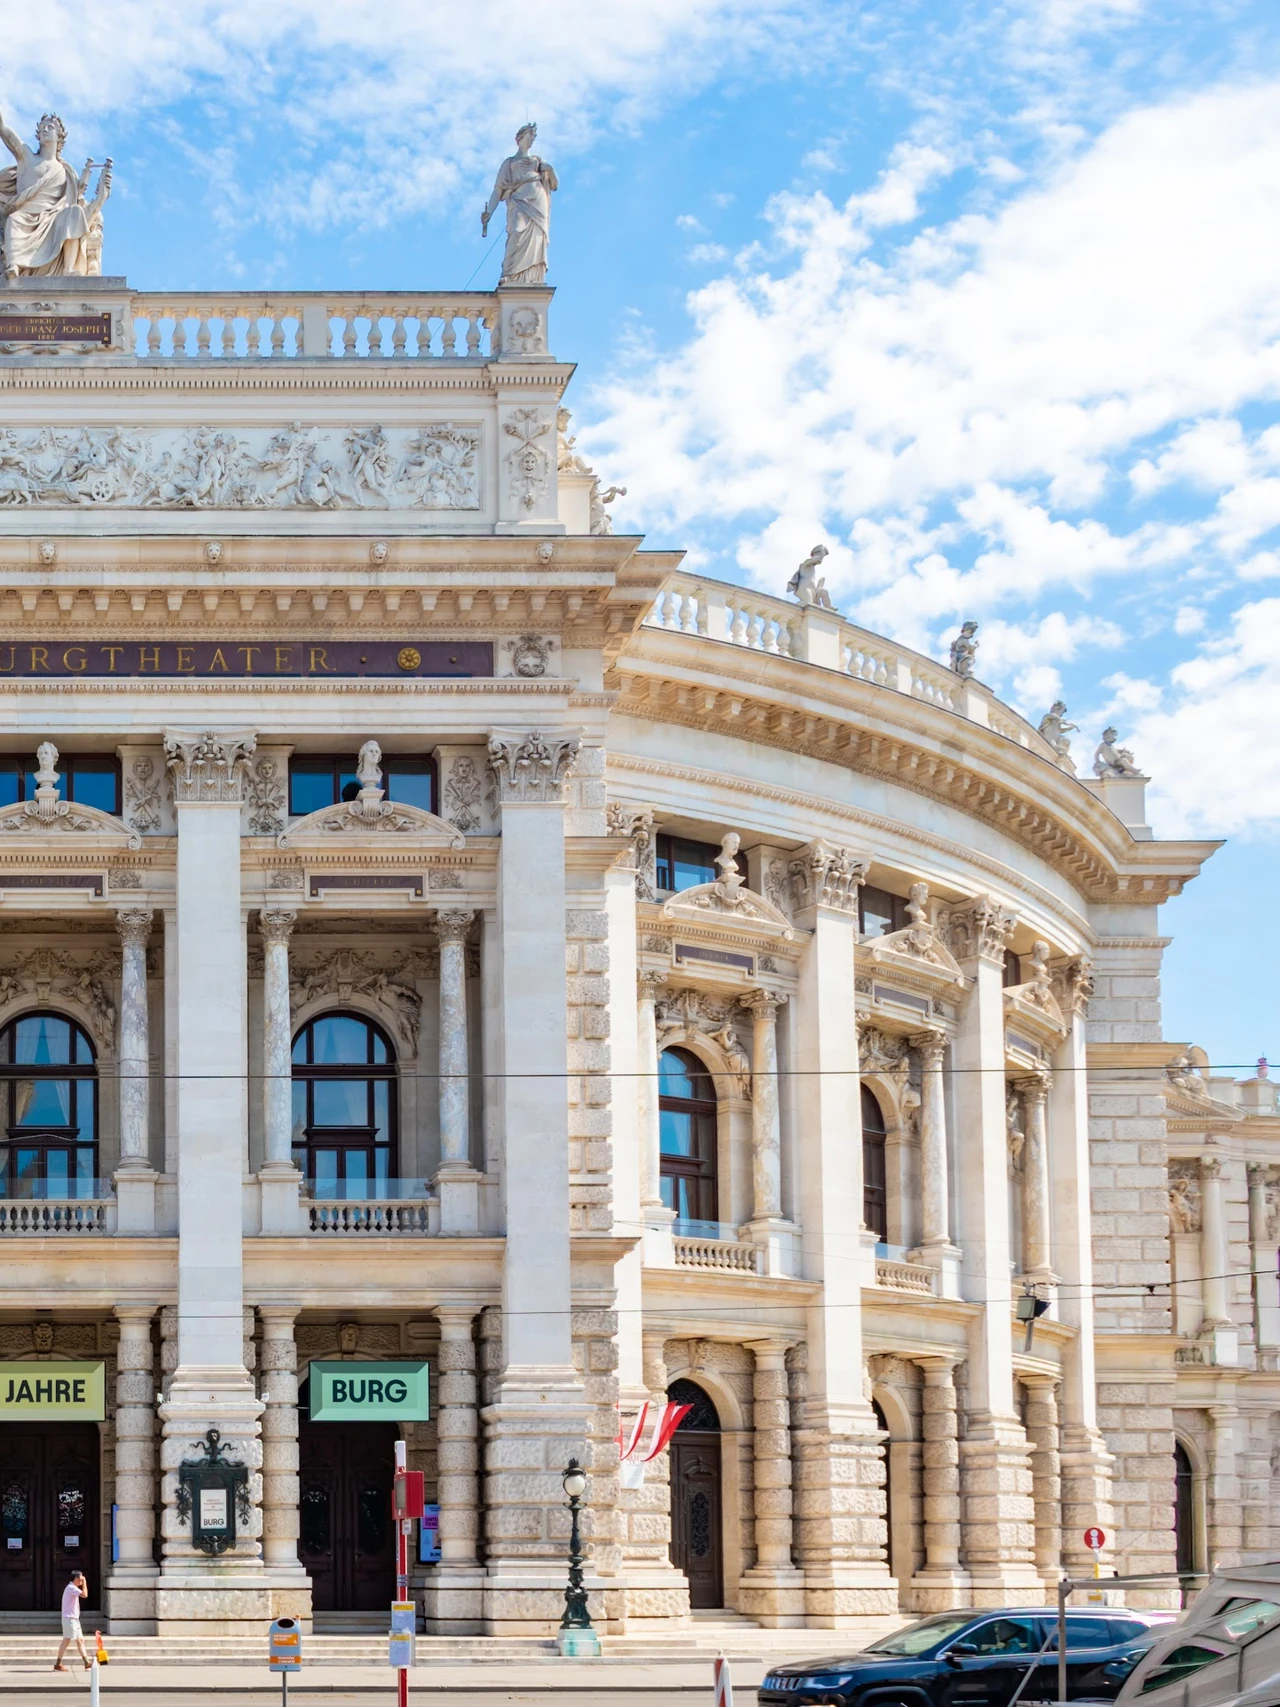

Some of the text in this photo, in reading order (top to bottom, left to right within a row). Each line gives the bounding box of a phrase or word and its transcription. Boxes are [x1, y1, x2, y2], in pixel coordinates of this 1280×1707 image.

[5, 1379, 86, 1403] JAHRE
[332, 1379, 408, 1403] BURG
[203, 1518, 225, 1526] BURG
